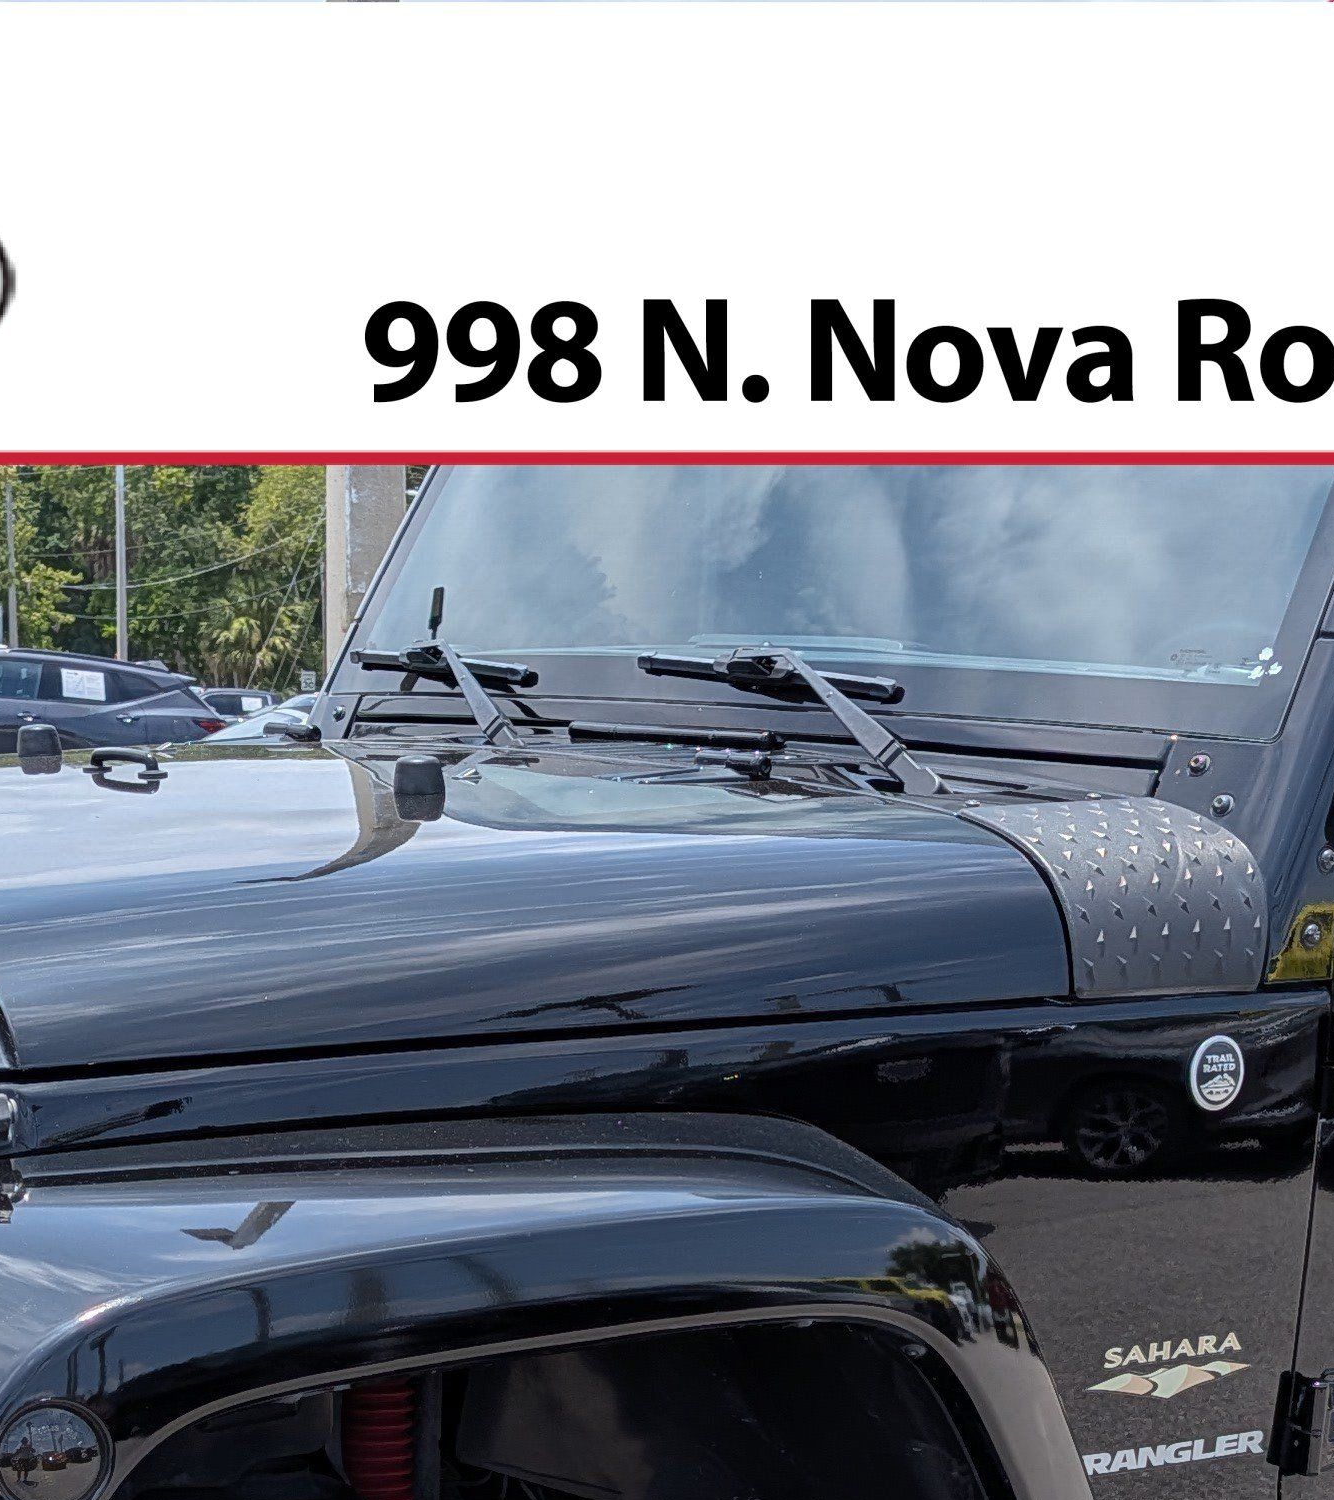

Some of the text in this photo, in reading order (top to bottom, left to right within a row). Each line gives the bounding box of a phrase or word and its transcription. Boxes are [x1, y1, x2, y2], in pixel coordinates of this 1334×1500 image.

[1202, 1063, 1236, 1073] RATED
[1205, 1053, 1235, 1064] TRAIL
[1103, 1332, 1242, 1369] SAHARA
[1081, 1430, 1264, 1475] RANGLER
